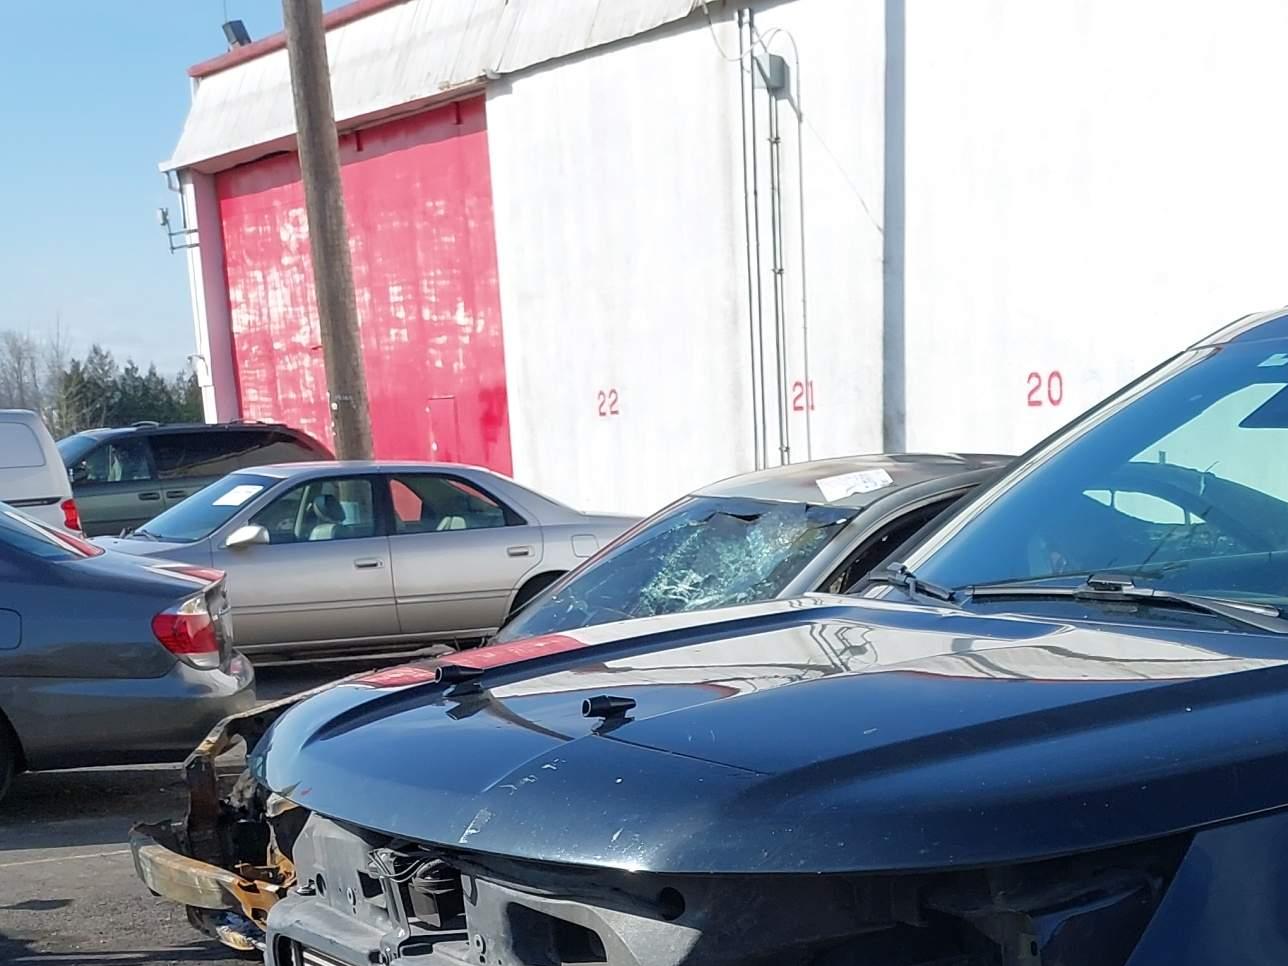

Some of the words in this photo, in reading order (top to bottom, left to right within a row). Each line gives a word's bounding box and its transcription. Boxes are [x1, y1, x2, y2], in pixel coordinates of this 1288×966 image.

[597, 389, 619, 416] 22
[792, 380, 815, 411] 21
[1027, 371, 1063, 406] 20
